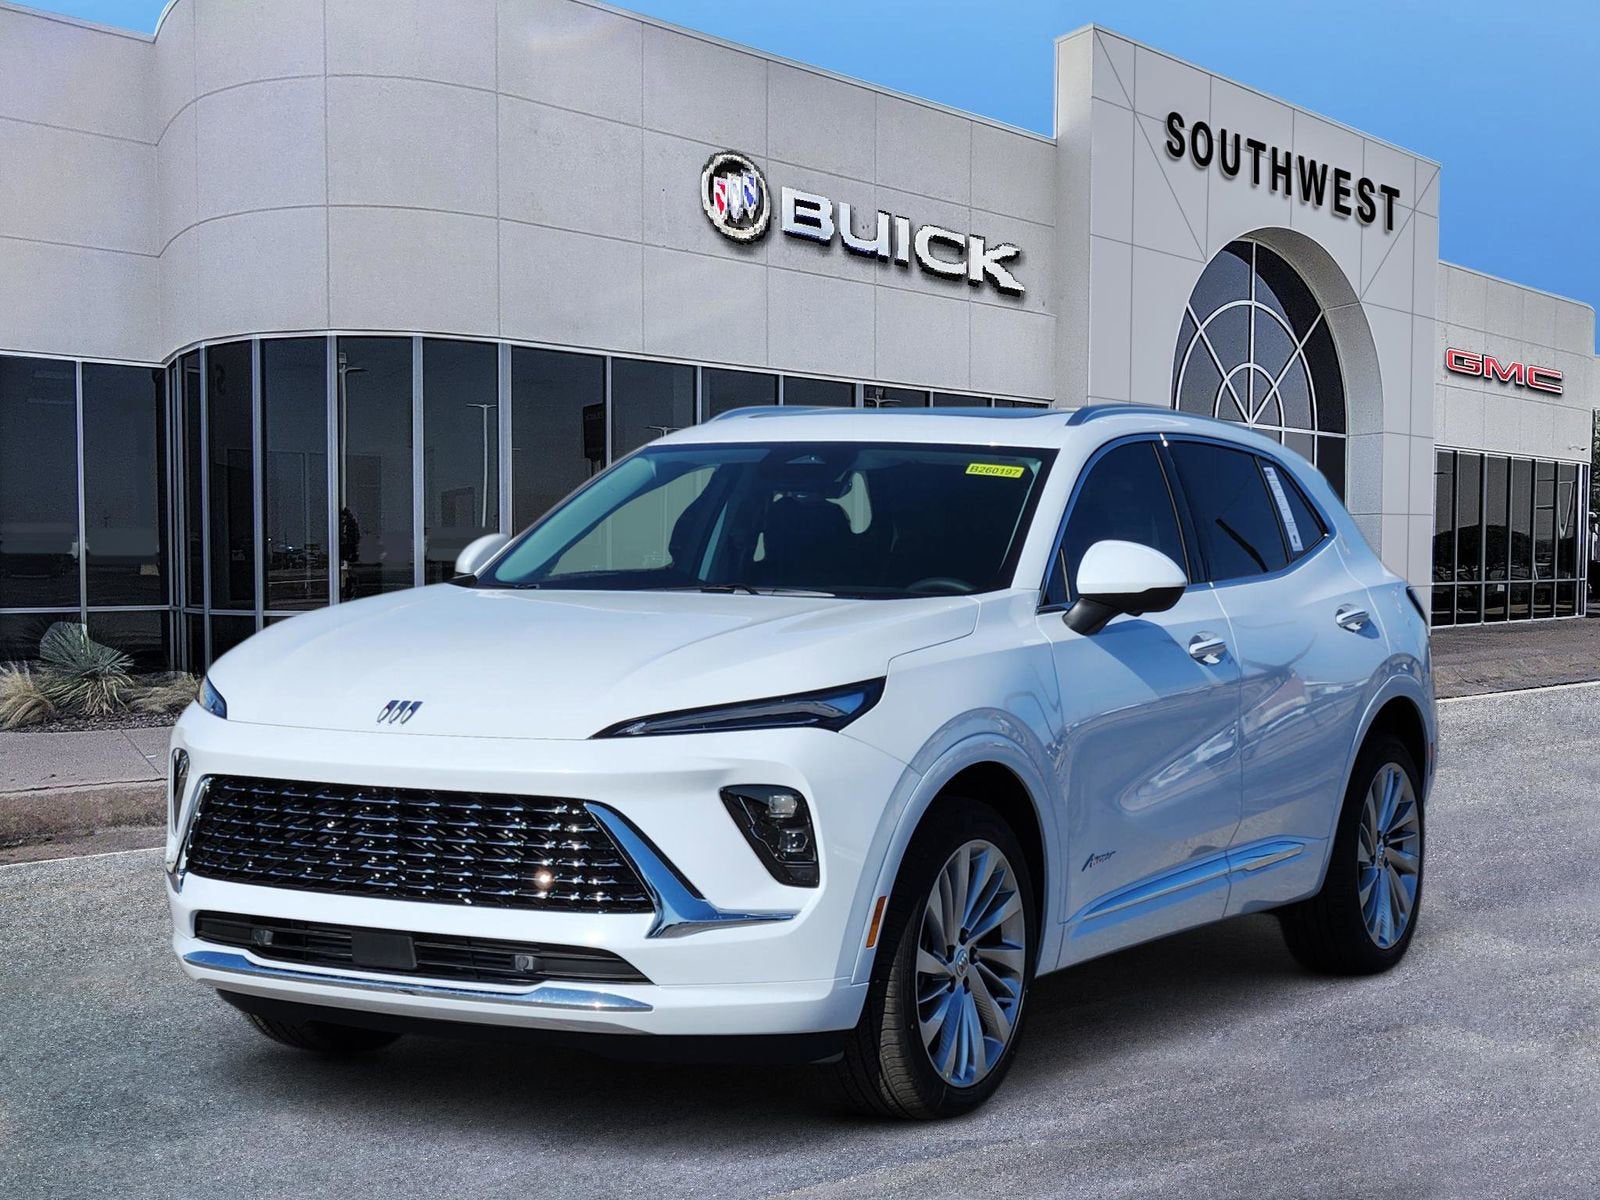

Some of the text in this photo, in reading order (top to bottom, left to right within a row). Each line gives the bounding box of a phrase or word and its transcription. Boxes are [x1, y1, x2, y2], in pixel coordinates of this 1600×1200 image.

[1166, 111, 1400, 231] SOUTHWEST
[781, 186, 1025, 297] BUICK
[1446, 347, 1563, 394] GMC
[969, 465, 1020, 476] B260197
